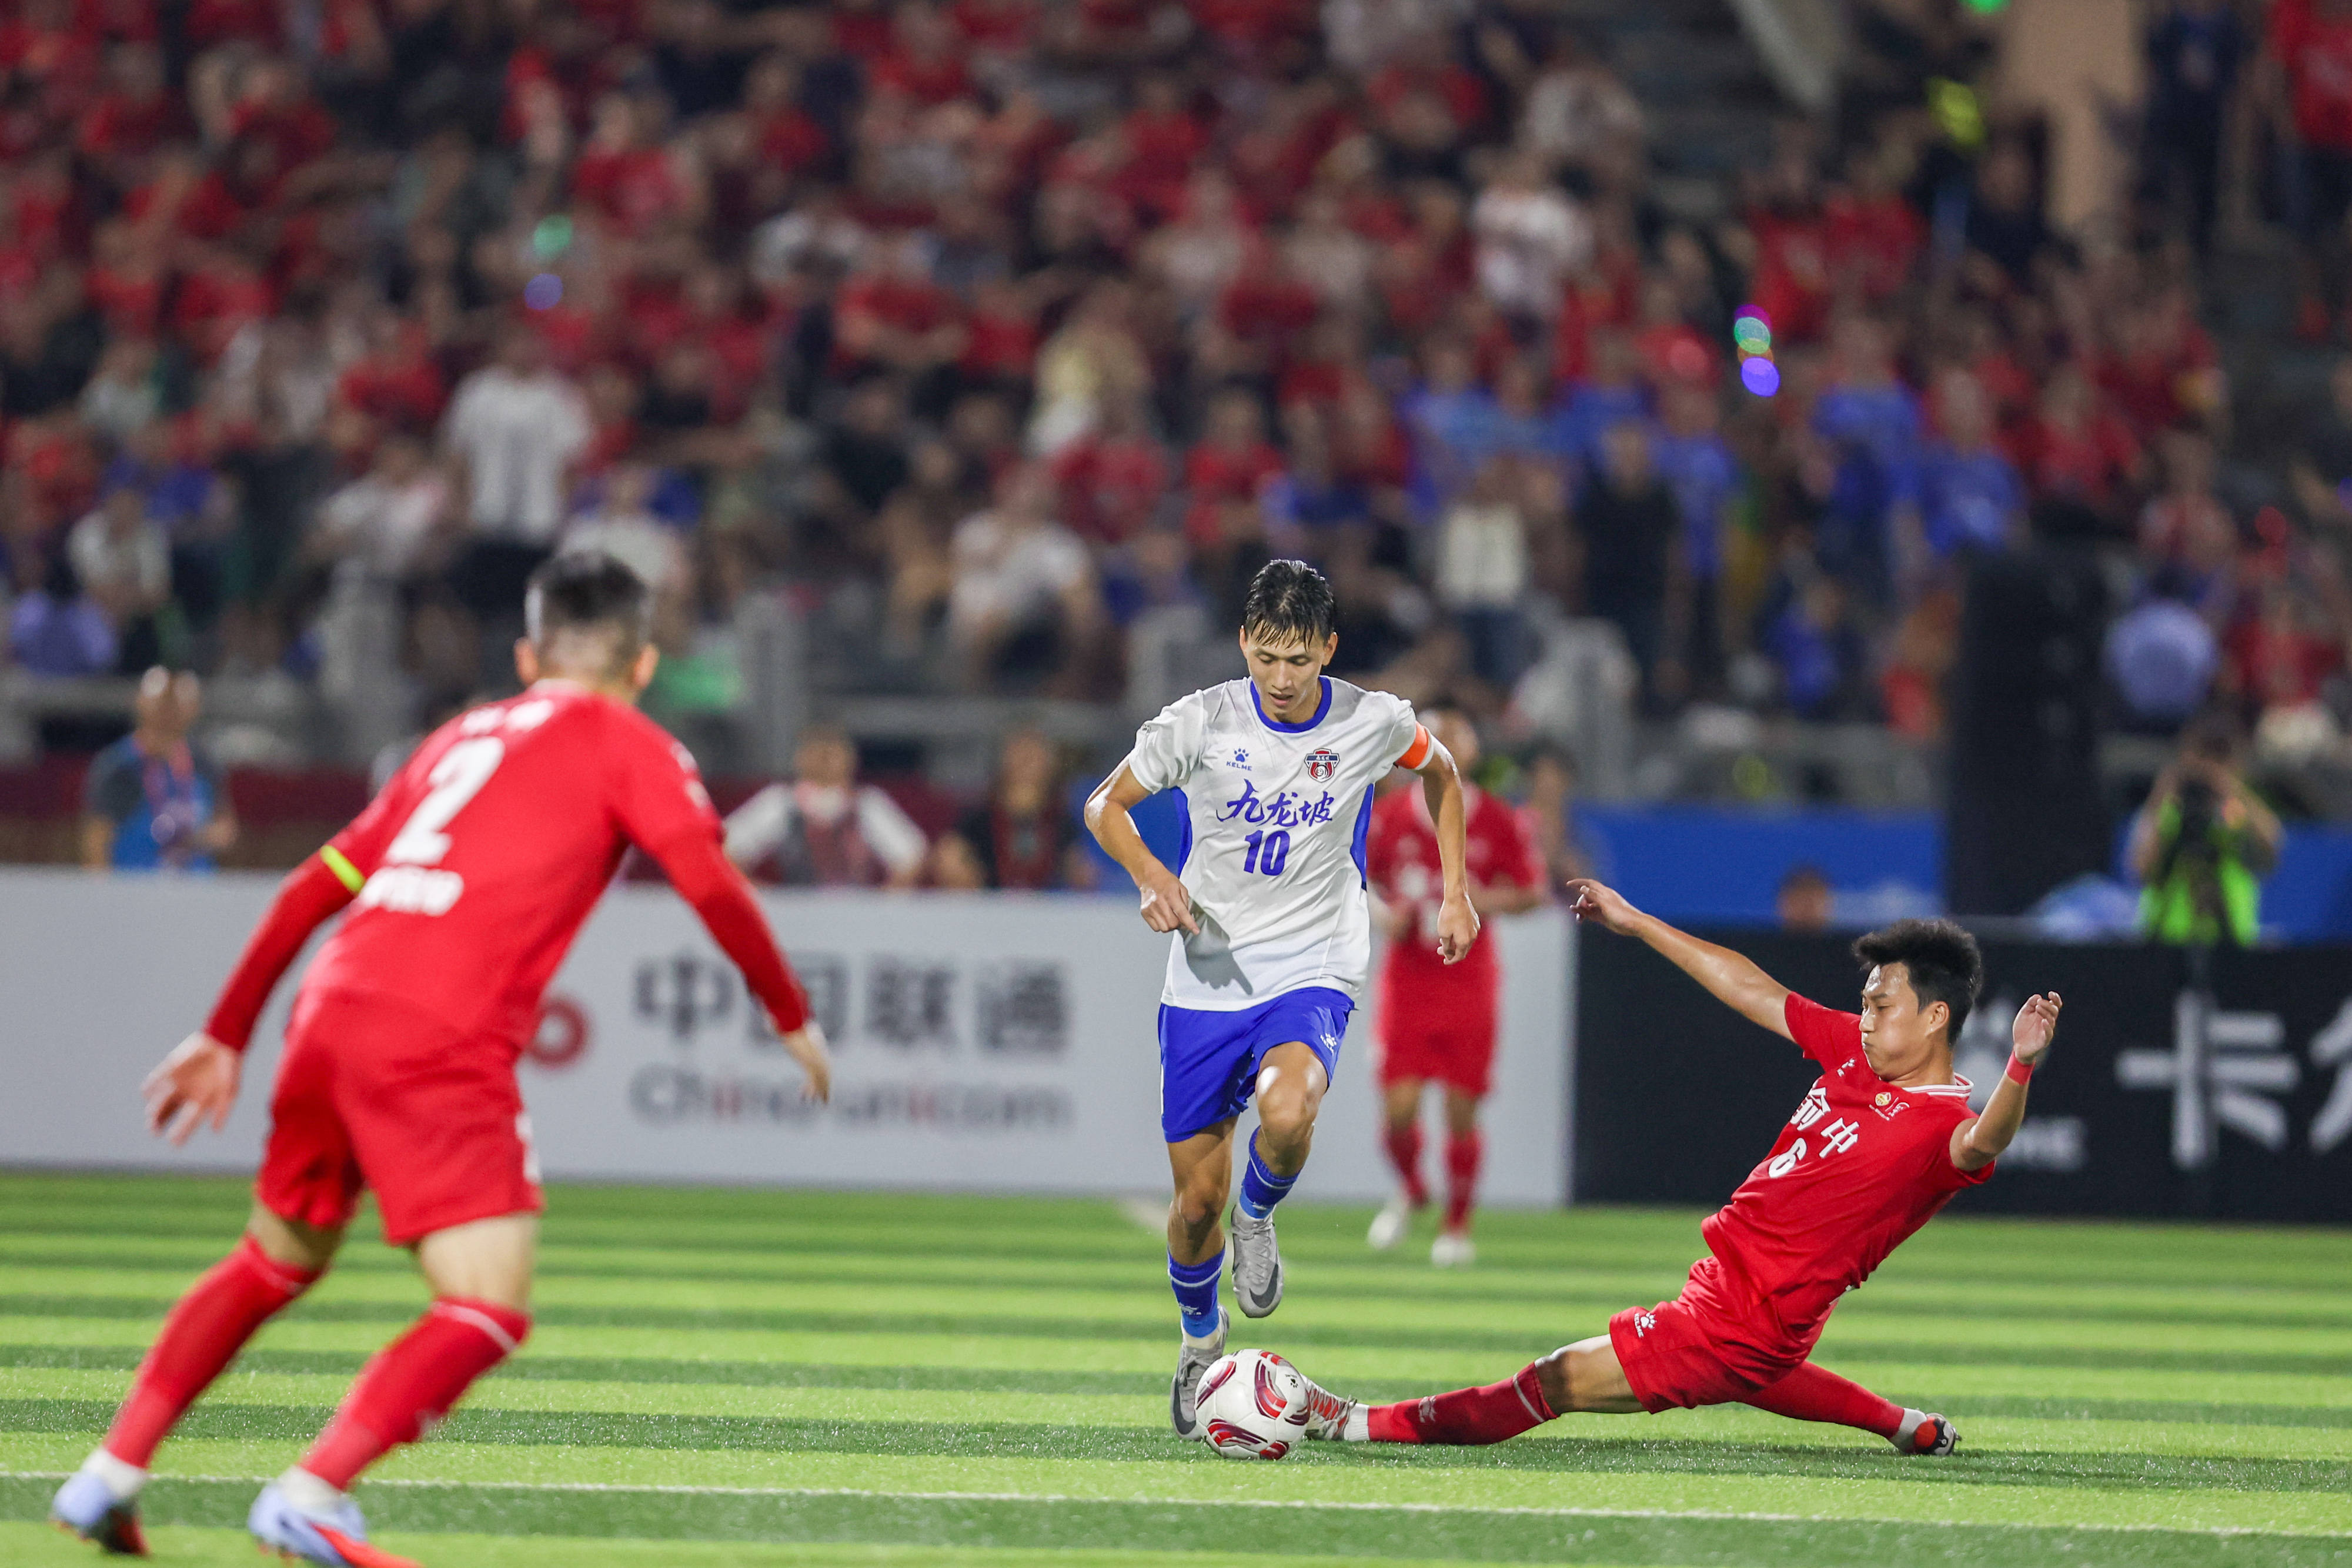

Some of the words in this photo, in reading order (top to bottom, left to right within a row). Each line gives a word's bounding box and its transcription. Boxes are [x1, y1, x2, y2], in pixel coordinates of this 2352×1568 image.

[1225, 761, 1252, 771] KELME
[385, 736, 506, 865] 2
[1215, 778, 1334, 827] 九龙坡
[1243, 829, 1291, 876] 10
[2117, 992, 2352, 1170] 卡
[1768, 1137, 1807, 1178] 6
[1634, 1312, 1644, 1338] KELME
